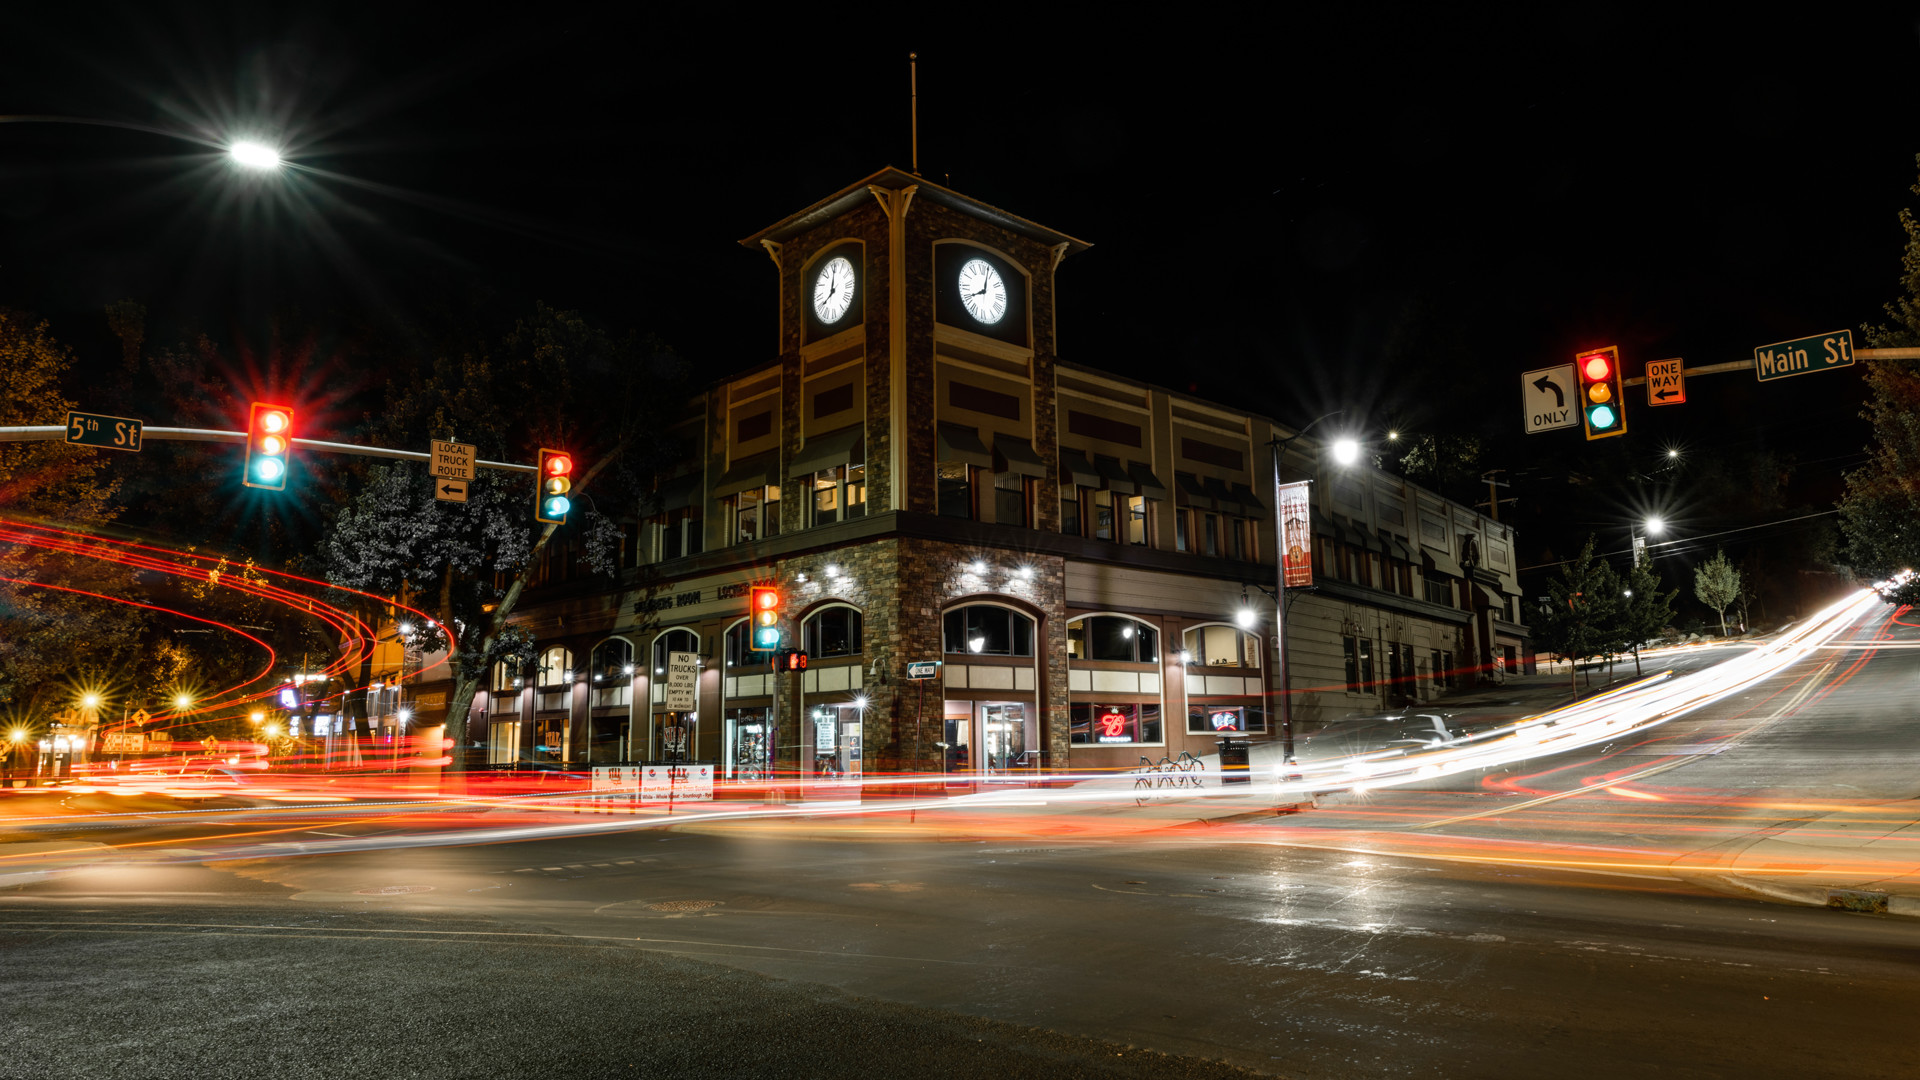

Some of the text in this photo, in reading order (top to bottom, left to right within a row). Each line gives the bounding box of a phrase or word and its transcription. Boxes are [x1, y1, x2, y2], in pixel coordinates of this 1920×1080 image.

[1759, 336, 1850, 376] Main St
[1651, 363, 1678, 376] ONE
[1651, 375, 1680, 388] WAY
[1533, 409, 1569, 426] ONLY
[71, 417, 138, 447] 5th St
[439, 443, 468, 455] LOCAL
[438, 454, 468, 466] TRUCK
[438, 466, 467, 477] ROUTE
[678, 654, 690, 663] NO
[670, 664, 696, 673] TRUCKS
